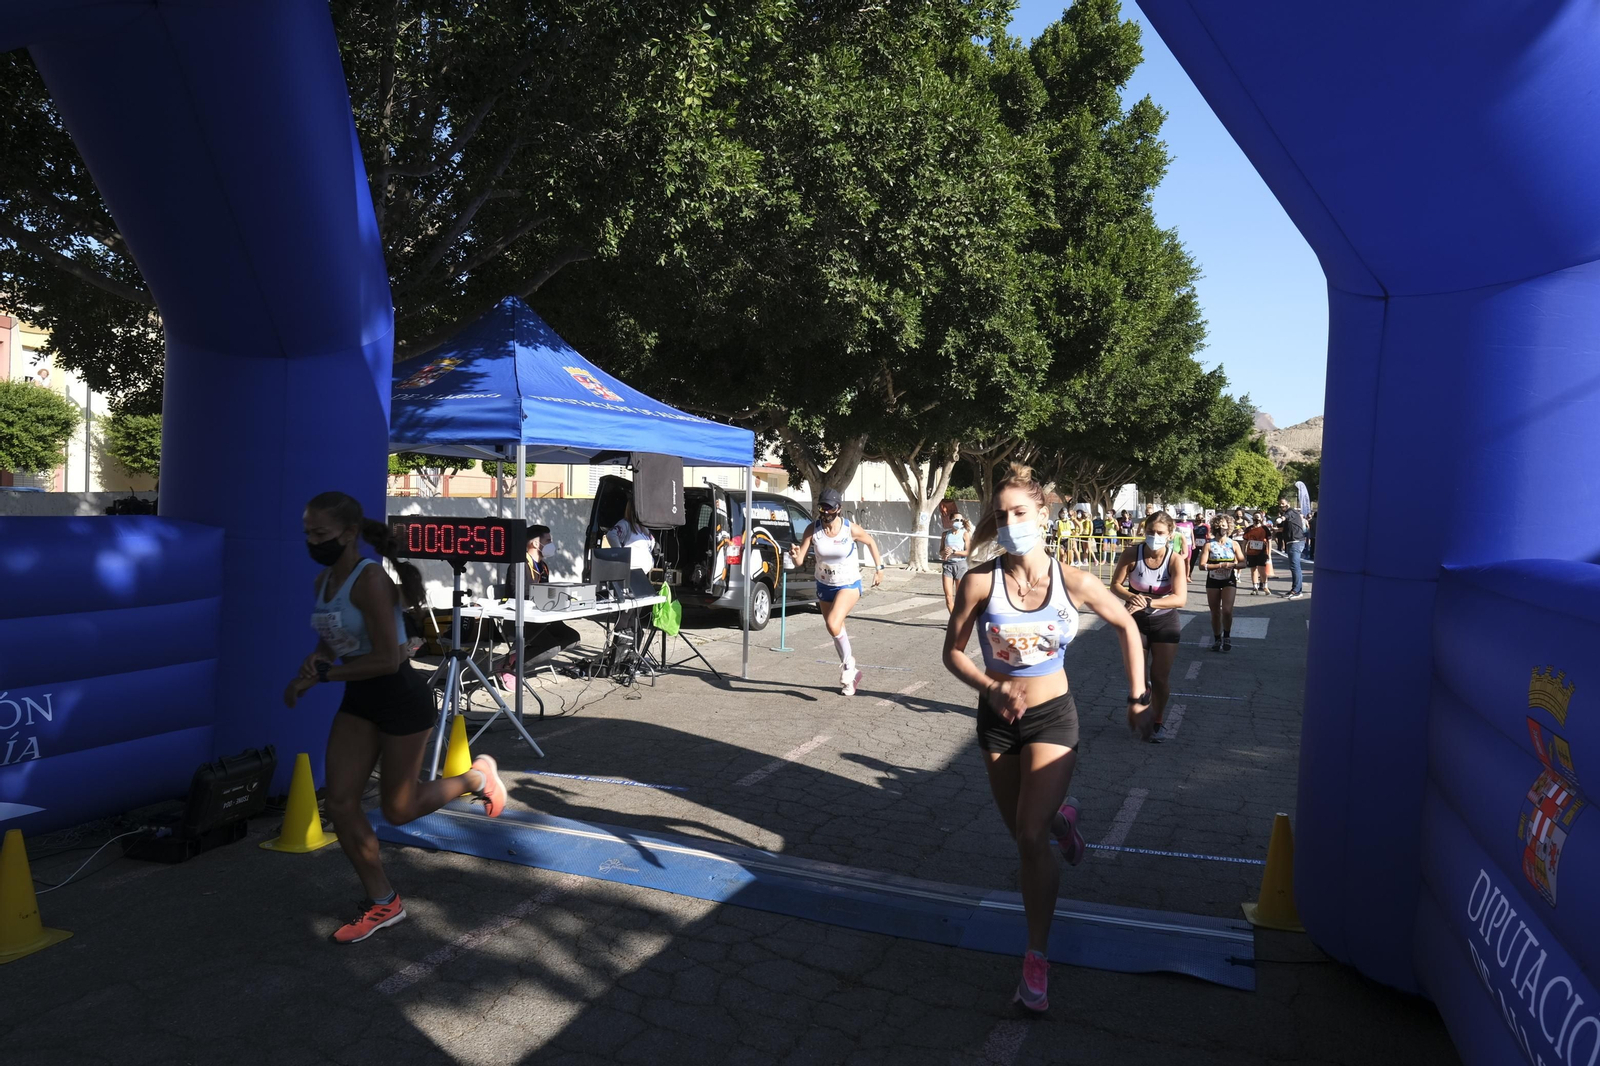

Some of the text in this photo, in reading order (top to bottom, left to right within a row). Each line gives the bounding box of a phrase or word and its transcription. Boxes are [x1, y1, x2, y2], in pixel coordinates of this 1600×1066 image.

[1006, 637, 1040, 650] 237
[1085, 843, 1121, 851] SEGURI
[1138, 848, 1189, 858] DISTANCIA
[1206, 855, 1262, 865] MANTENGA
